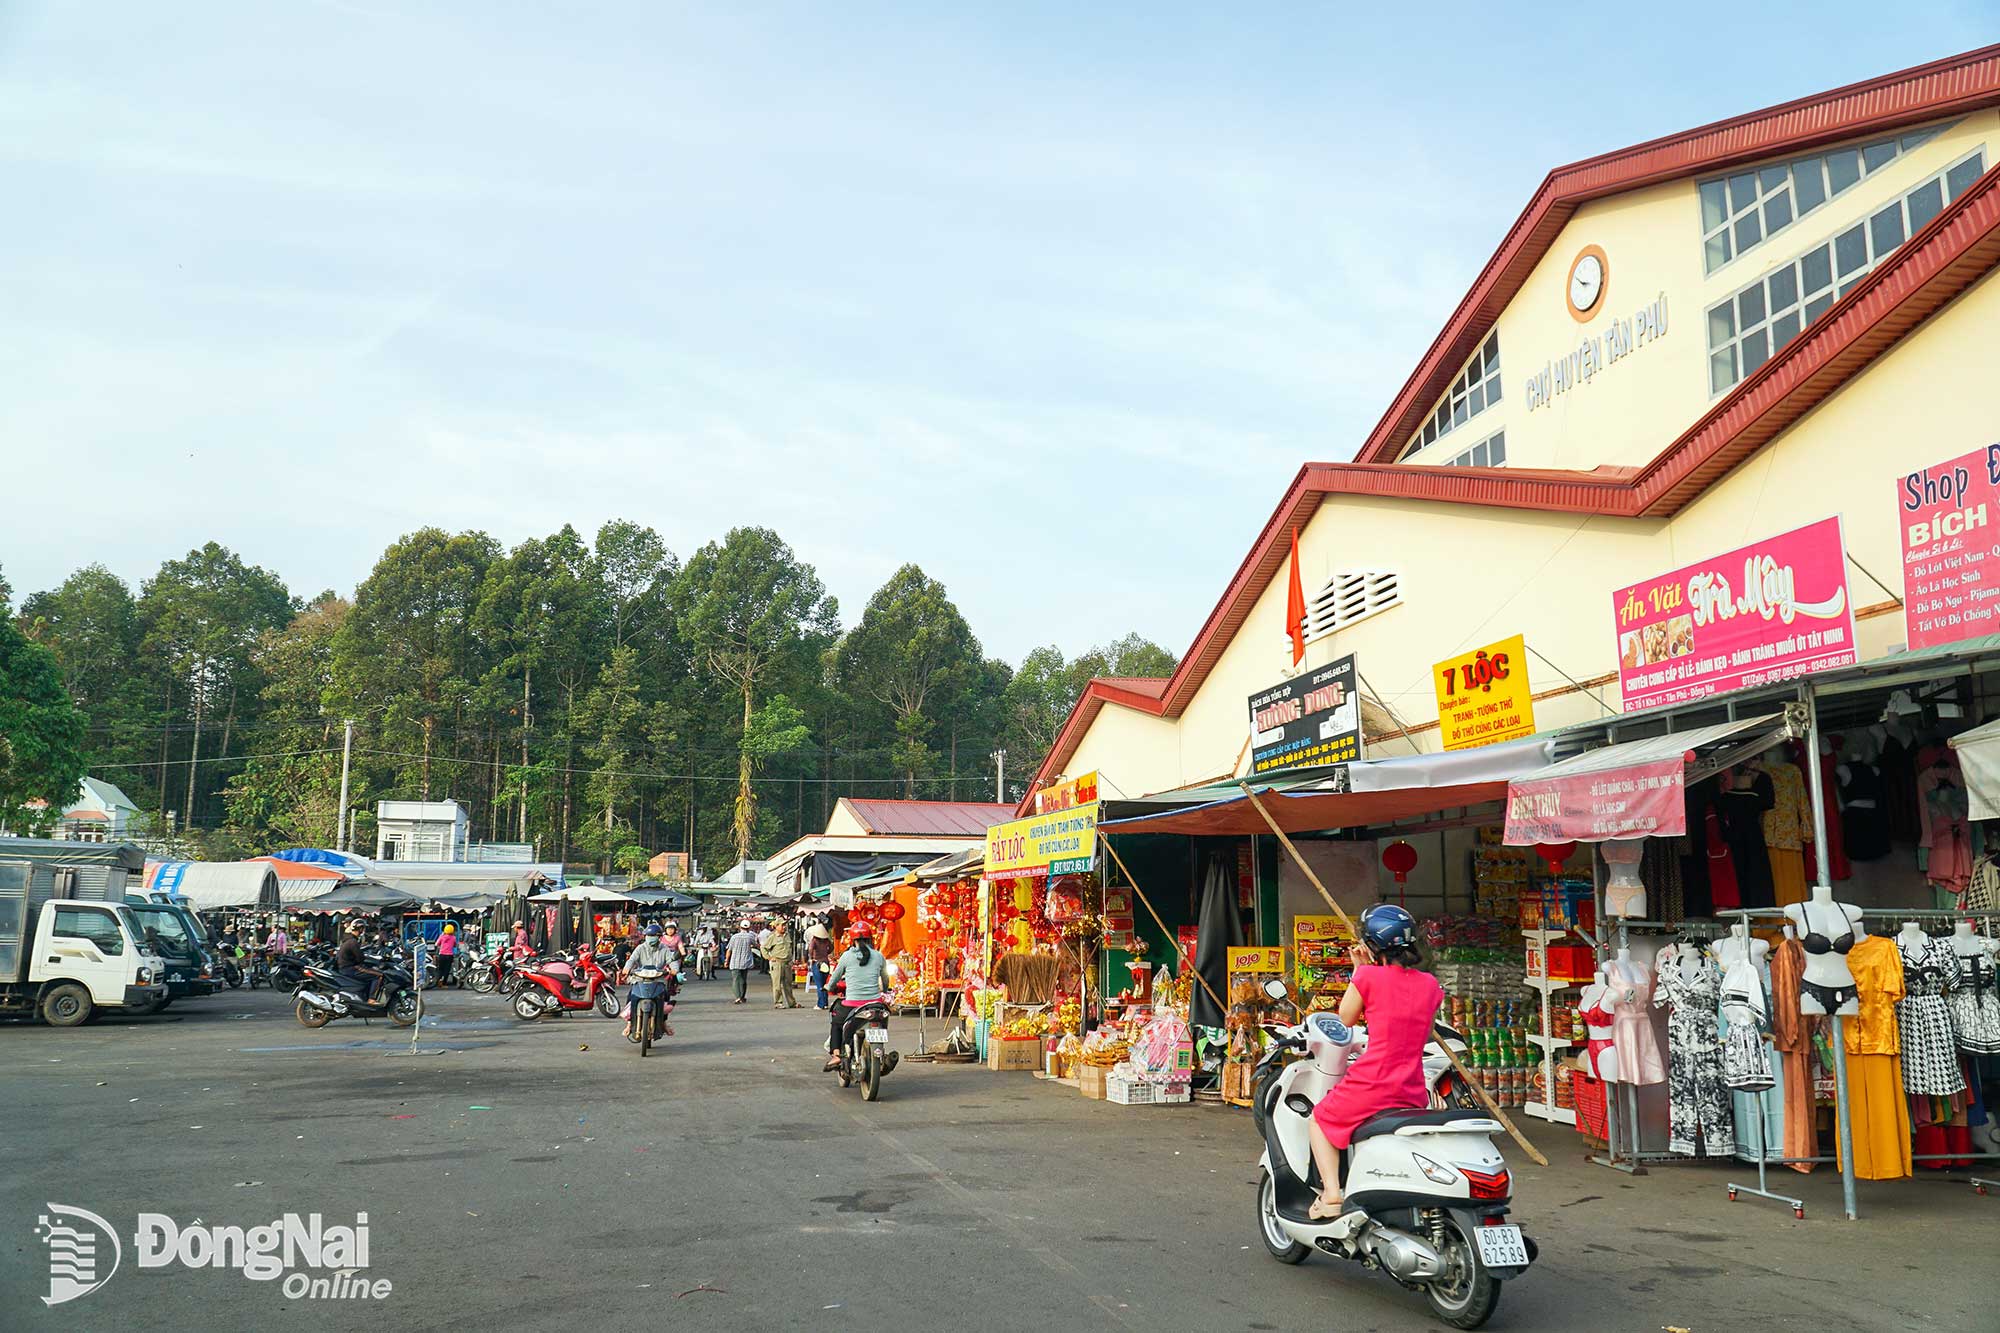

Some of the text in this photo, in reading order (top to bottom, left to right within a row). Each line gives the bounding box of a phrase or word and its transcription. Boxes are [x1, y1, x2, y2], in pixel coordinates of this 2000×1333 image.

[1526, 291, 1669, 412] CHỢ HUYỆN TÂN PHÚ
[1904, 467, 1969, 512] Shop
[1908, 504, 1987, 548] BÍCH
[1964, 552, 1984, 565] Nam
[1942, 577, 1959, 591] Học
[1961, 569, 1981, 584] Sinh
[1619, 589, 1647, 626] Ăn
[1648, 582, 1683, 616] Vặt
[1687, 571, 1737, 627] Trà
[1442, 650, 1510, 695] 7 LỘC
[1626, 674, 1648, 692] CHUYÊN
[1649, 671, 1665, 686] CUNG
[1665, 664, 1678, 682] CẤP
[1695, 657, 1713, 675] BÁNH
[1713, 655, 1727, 672] KẸO
[1731, 649, 1751, 667] BÁNH
[1751, 643, 1776, 661] TRÁNG
[1807, 630, 1822, 649] TÂY
[1705, 683, 1715, 693] Nai
[1453, 710, 1474, 723] TRANH
[1534, 786, 1561, 818] THỦY
[1008, 832, 1025, 865] LỘC
[1235, 952, 1261, 969] JOJO
[1484, 1246, 1525, 1264] 625.89
